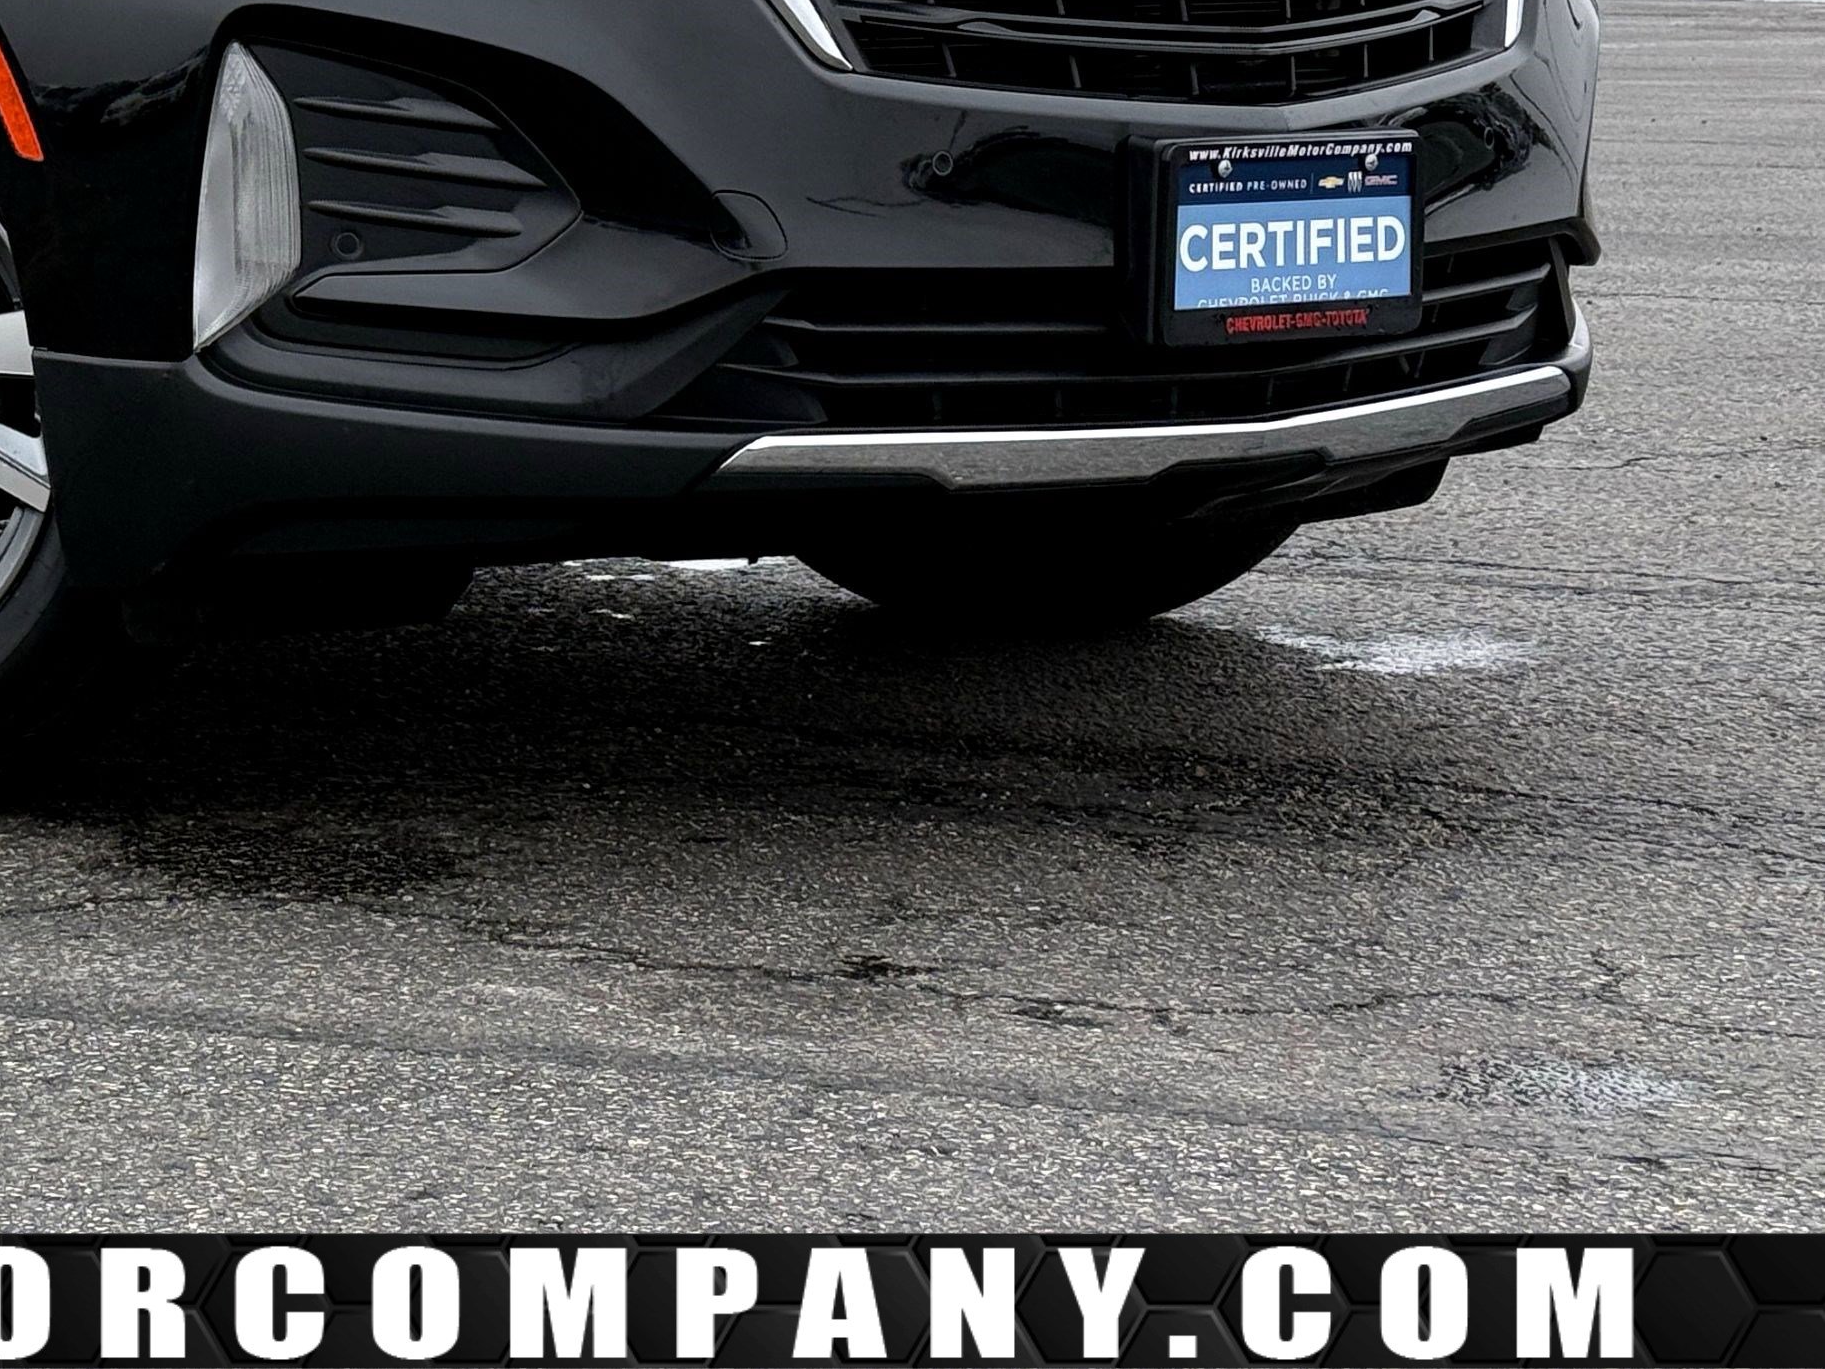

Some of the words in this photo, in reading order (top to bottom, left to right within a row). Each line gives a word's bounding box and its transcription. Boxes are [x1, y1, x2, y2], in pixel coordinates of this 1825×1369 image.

[1189, 141, 1413, 161] www.KirksvilleMotorCompany.com
[1188, 182, 1243, 194] CERTIFIED
[1246, 179, 1307, 192] PRE-OWNED
[1179, 215, 1406, 272] CERTIFIED
[1250, 276, 1312, 293] BACKED
[1317, 274, 1337, 289] BY
